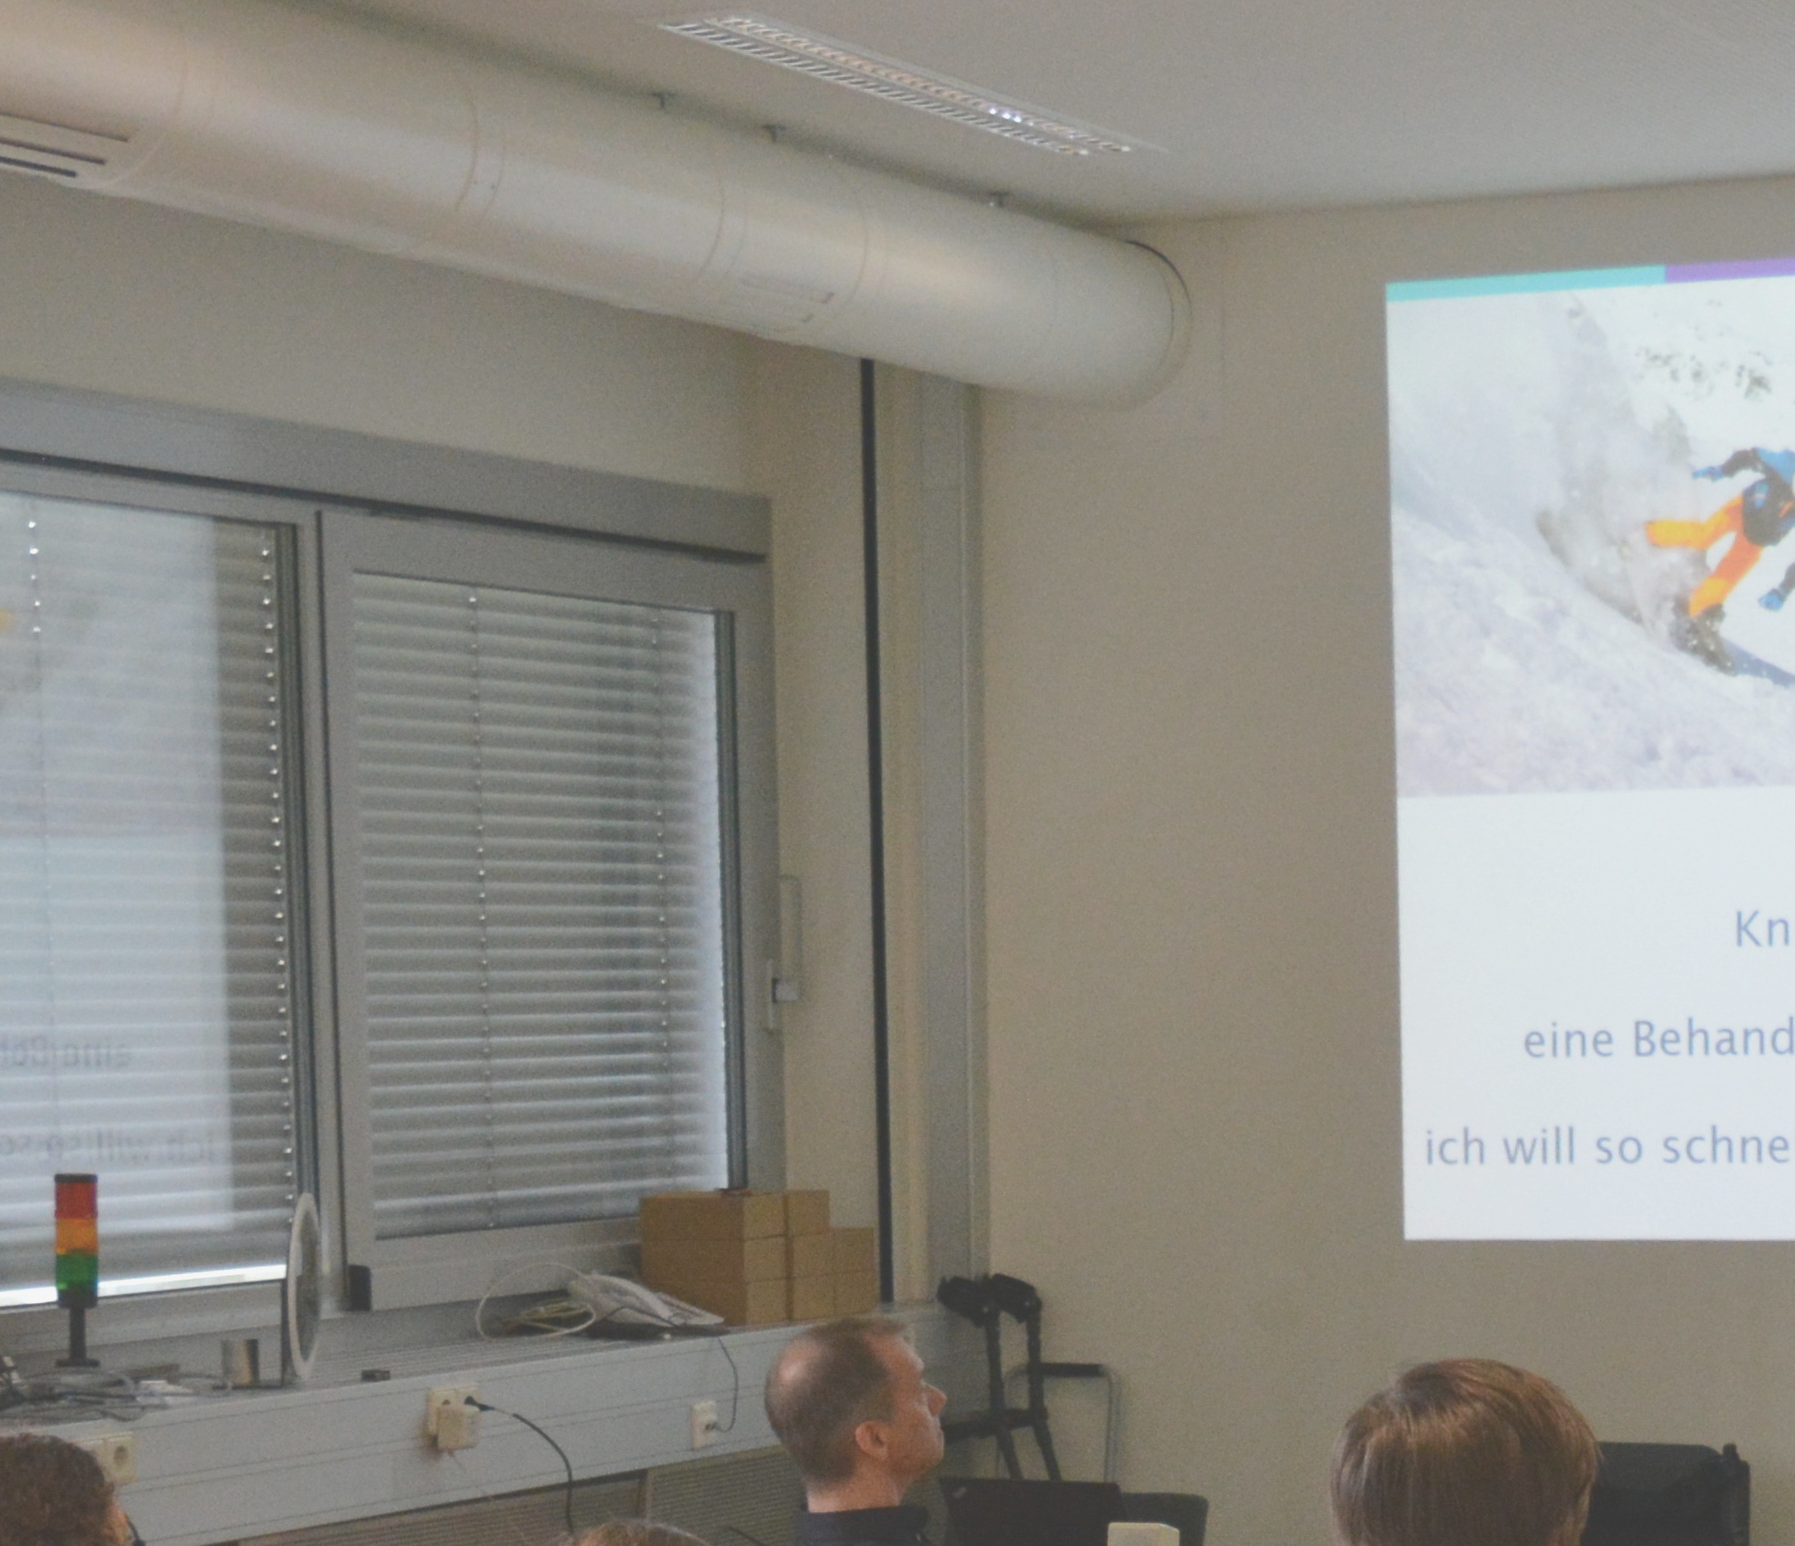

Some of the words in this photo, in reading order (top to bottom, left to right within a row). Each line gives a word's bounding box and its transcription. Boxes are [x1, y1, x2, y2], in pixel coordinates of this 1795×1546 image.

[1523, 1021, 1614, 1059] eine
[1426, 1126, 1486, 1166] ich
[1502, 1125, 1575, 1165] will
[1595, 1135, 1644, 1165] so
